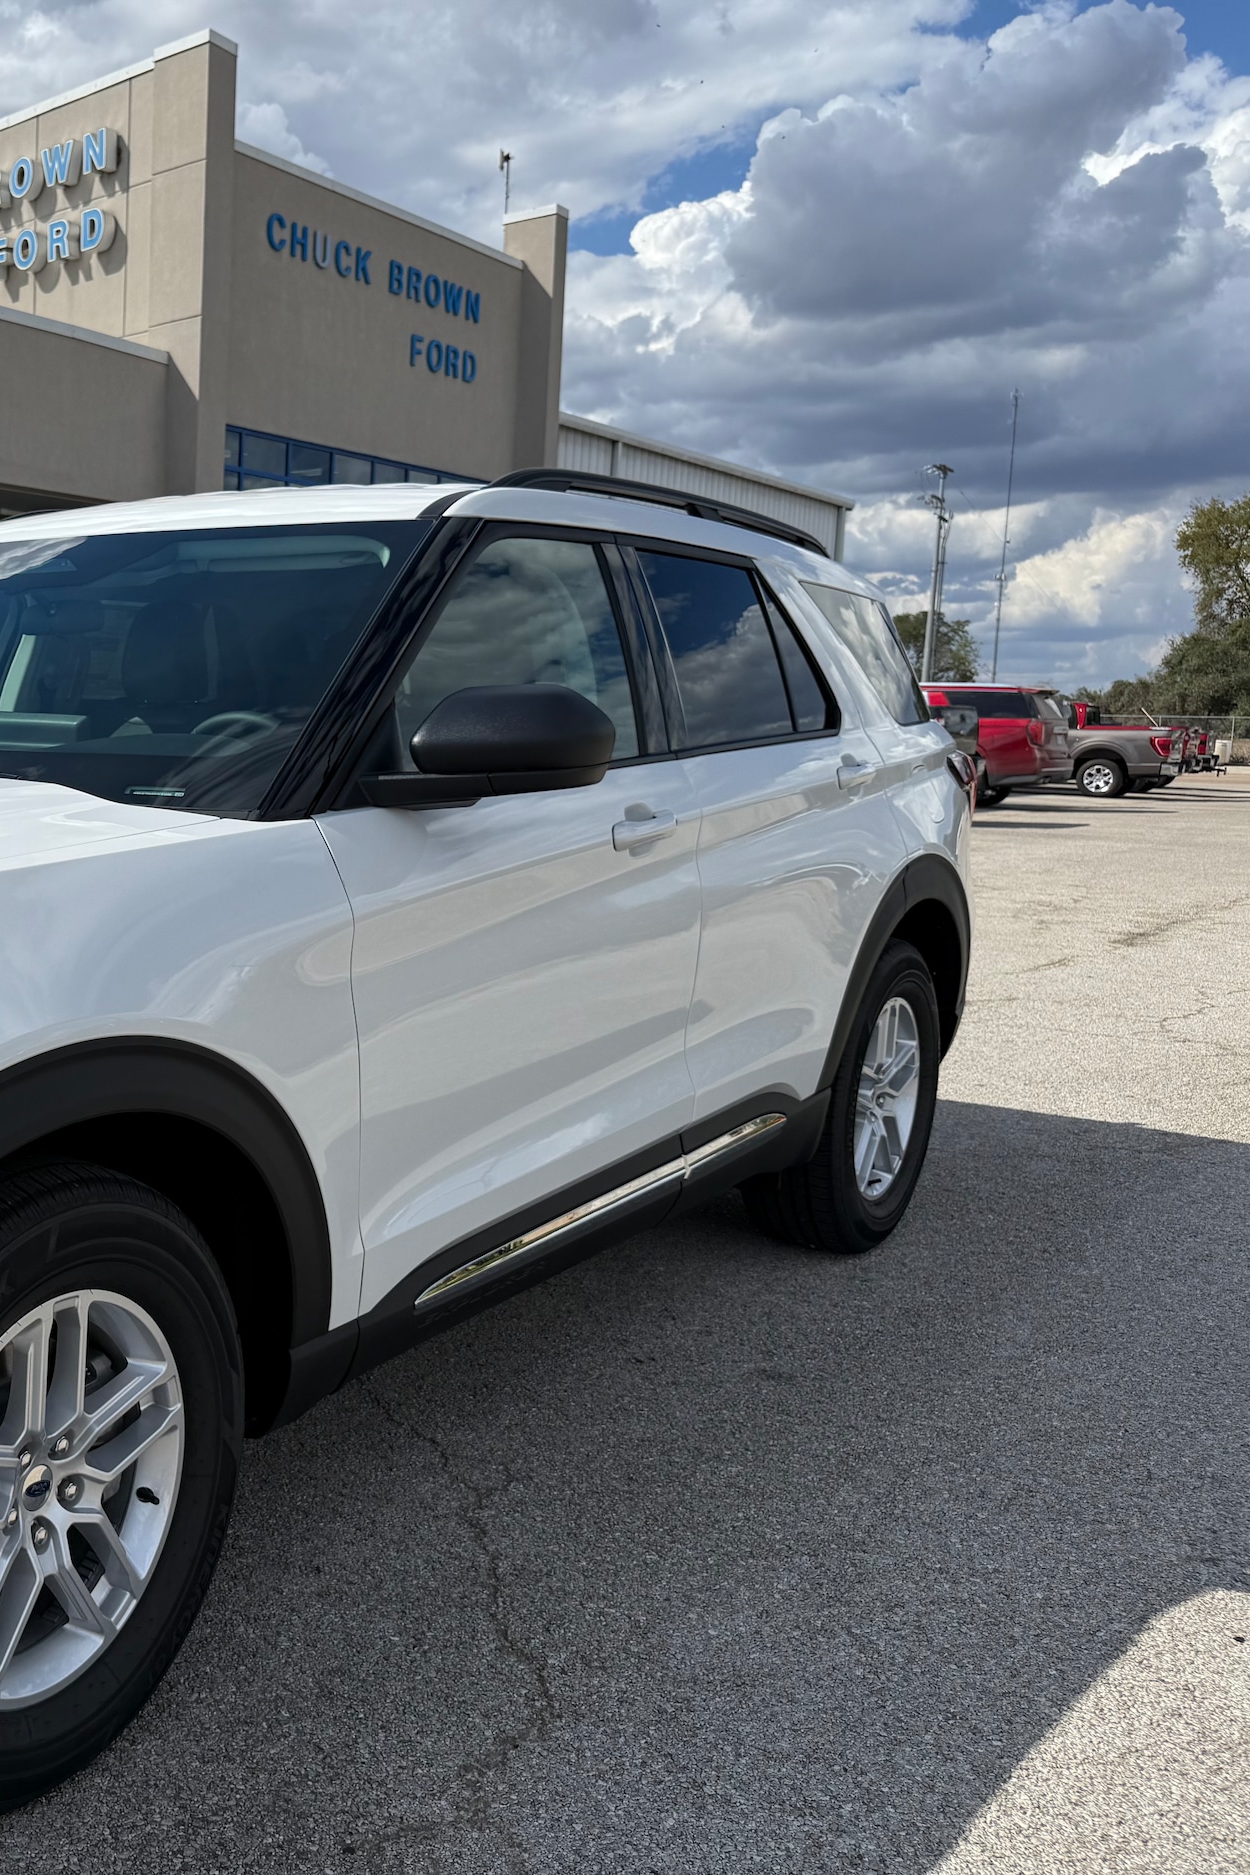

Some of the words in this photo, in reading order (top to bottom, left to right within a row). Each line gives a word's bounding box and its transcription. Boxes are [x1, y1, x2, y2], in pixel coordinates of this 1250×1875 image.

[266, 212, 373, 285] CHUCK
[388, 259, 482, 324] BROWN
[409, 333, 478, 383] FORD
